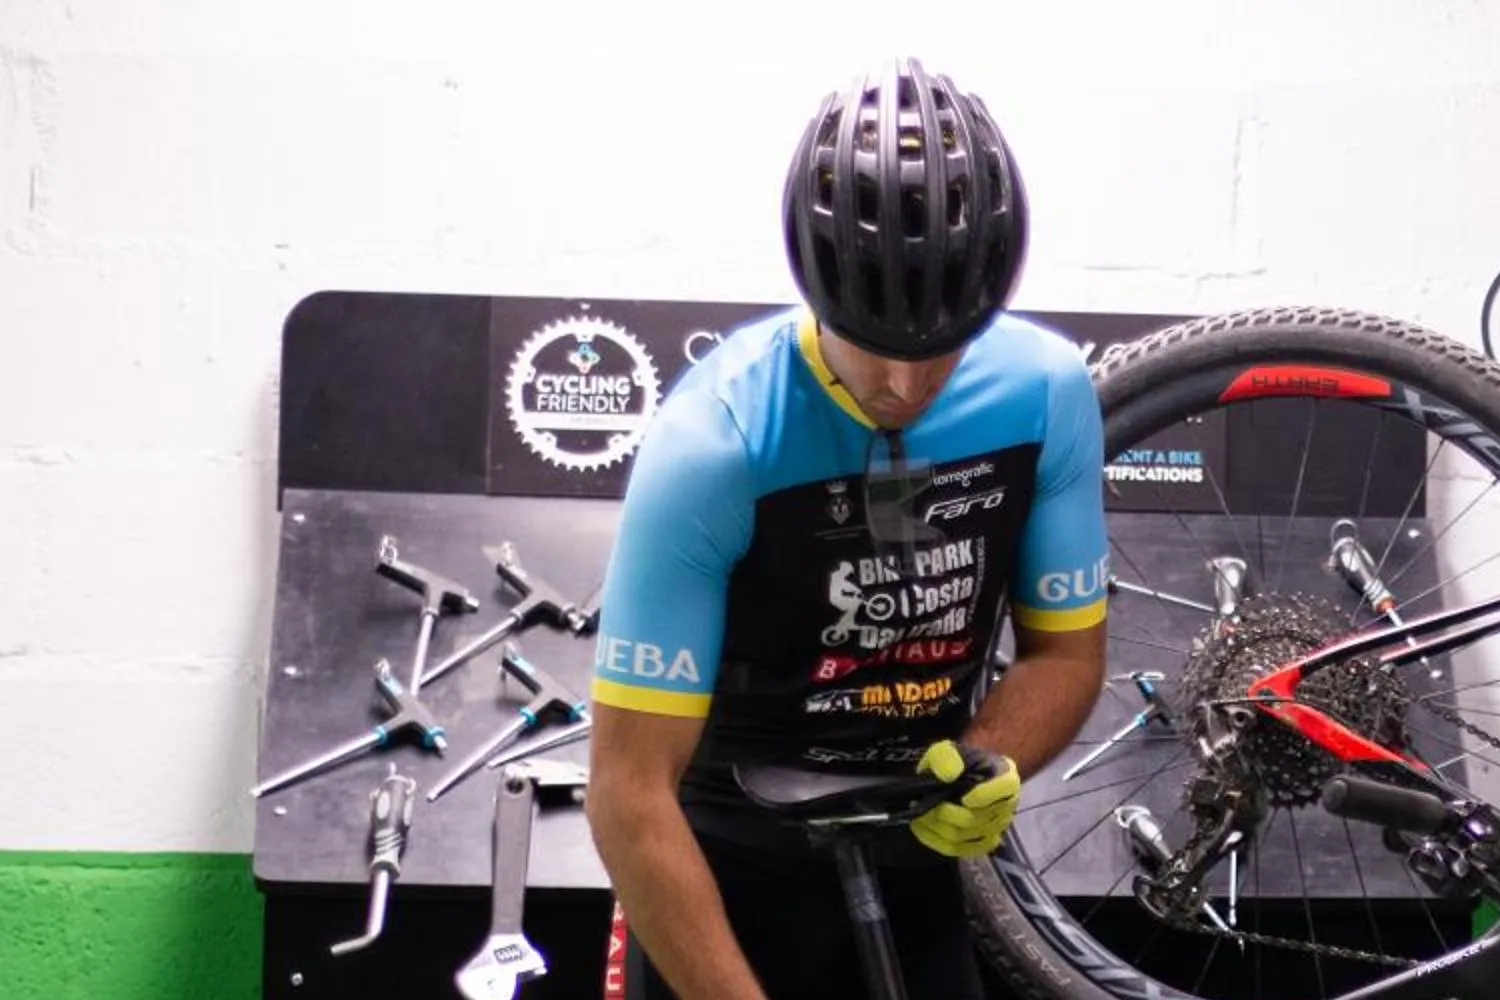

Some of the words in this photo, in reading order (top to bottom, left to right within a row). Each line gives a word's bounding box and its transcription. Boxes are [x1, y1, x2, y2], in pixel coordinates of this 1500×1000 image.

[535, 374, 631, 395] CYCLING
[536, 394, 631, 413] FRIENDLY
[1154, 451, 1166, 464] A
[1169, 451, 1203, 465] BIKE
[914, 538, 975, 577] PARK
